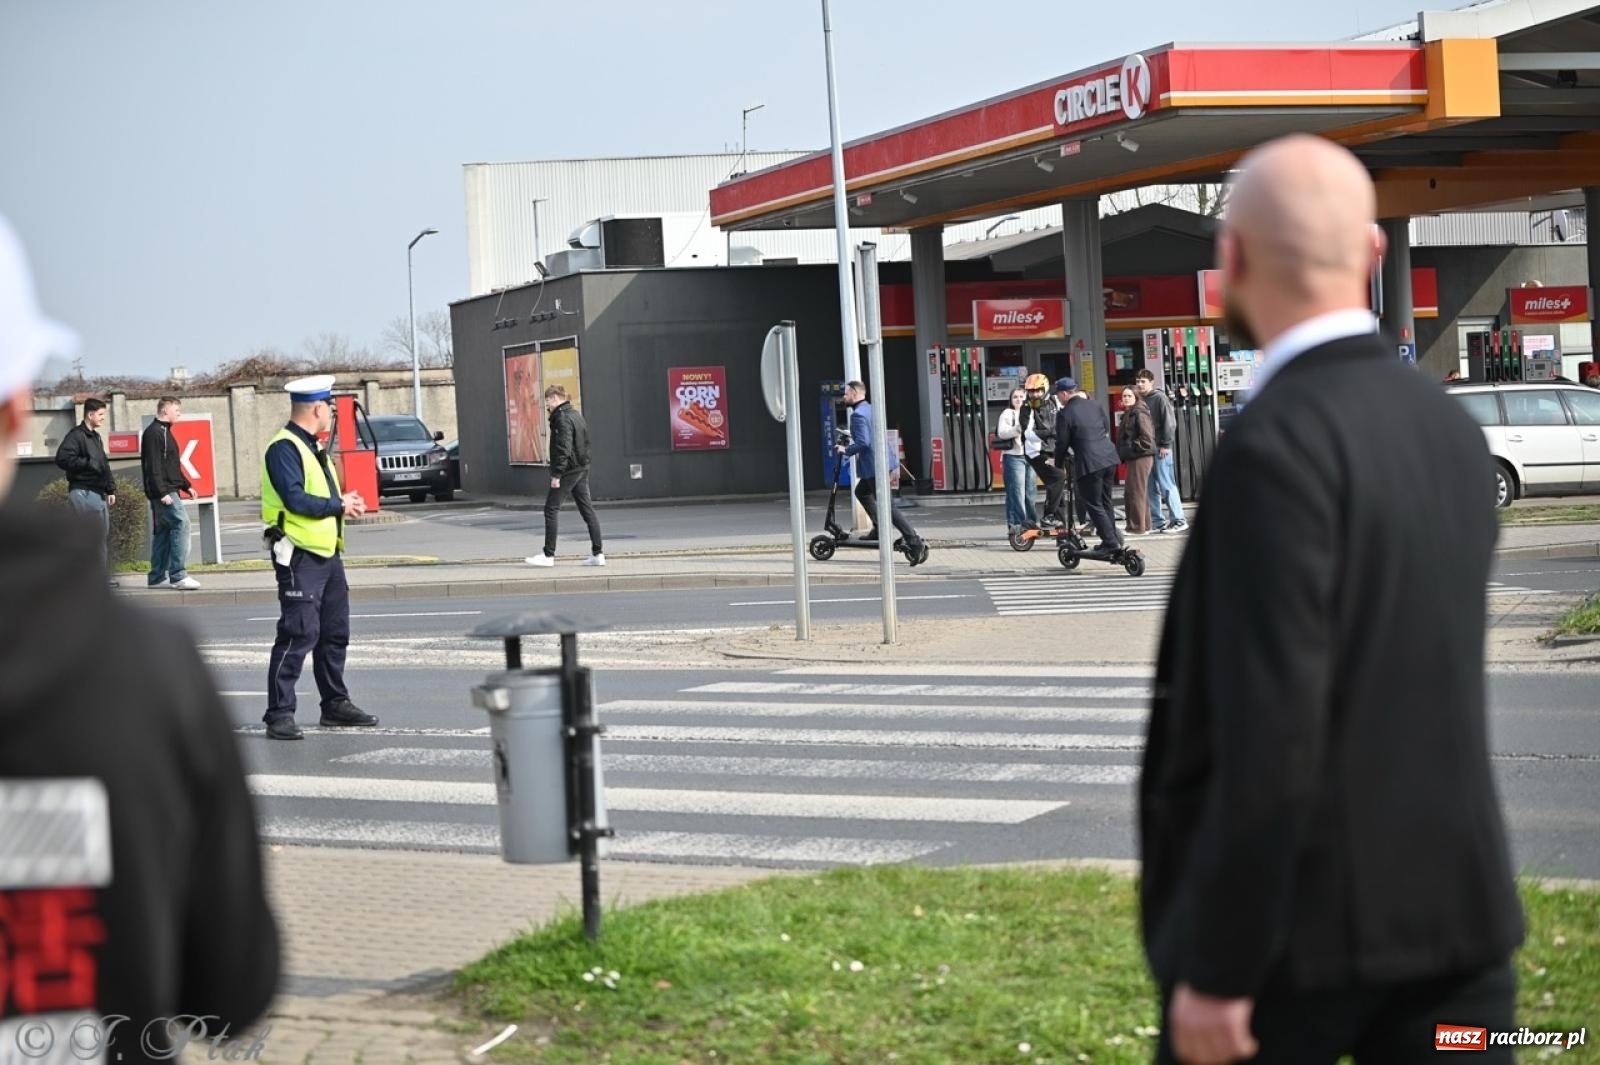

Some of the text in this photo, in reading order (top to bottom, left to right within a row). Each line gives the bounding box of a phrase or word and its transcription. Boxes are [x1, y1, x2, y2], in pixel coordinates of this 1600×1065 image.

[1054, 74, 1121, 125] CIRCLE
[1398, 345, 1410, 361] P
[675, 385, 720, 399] CORN
